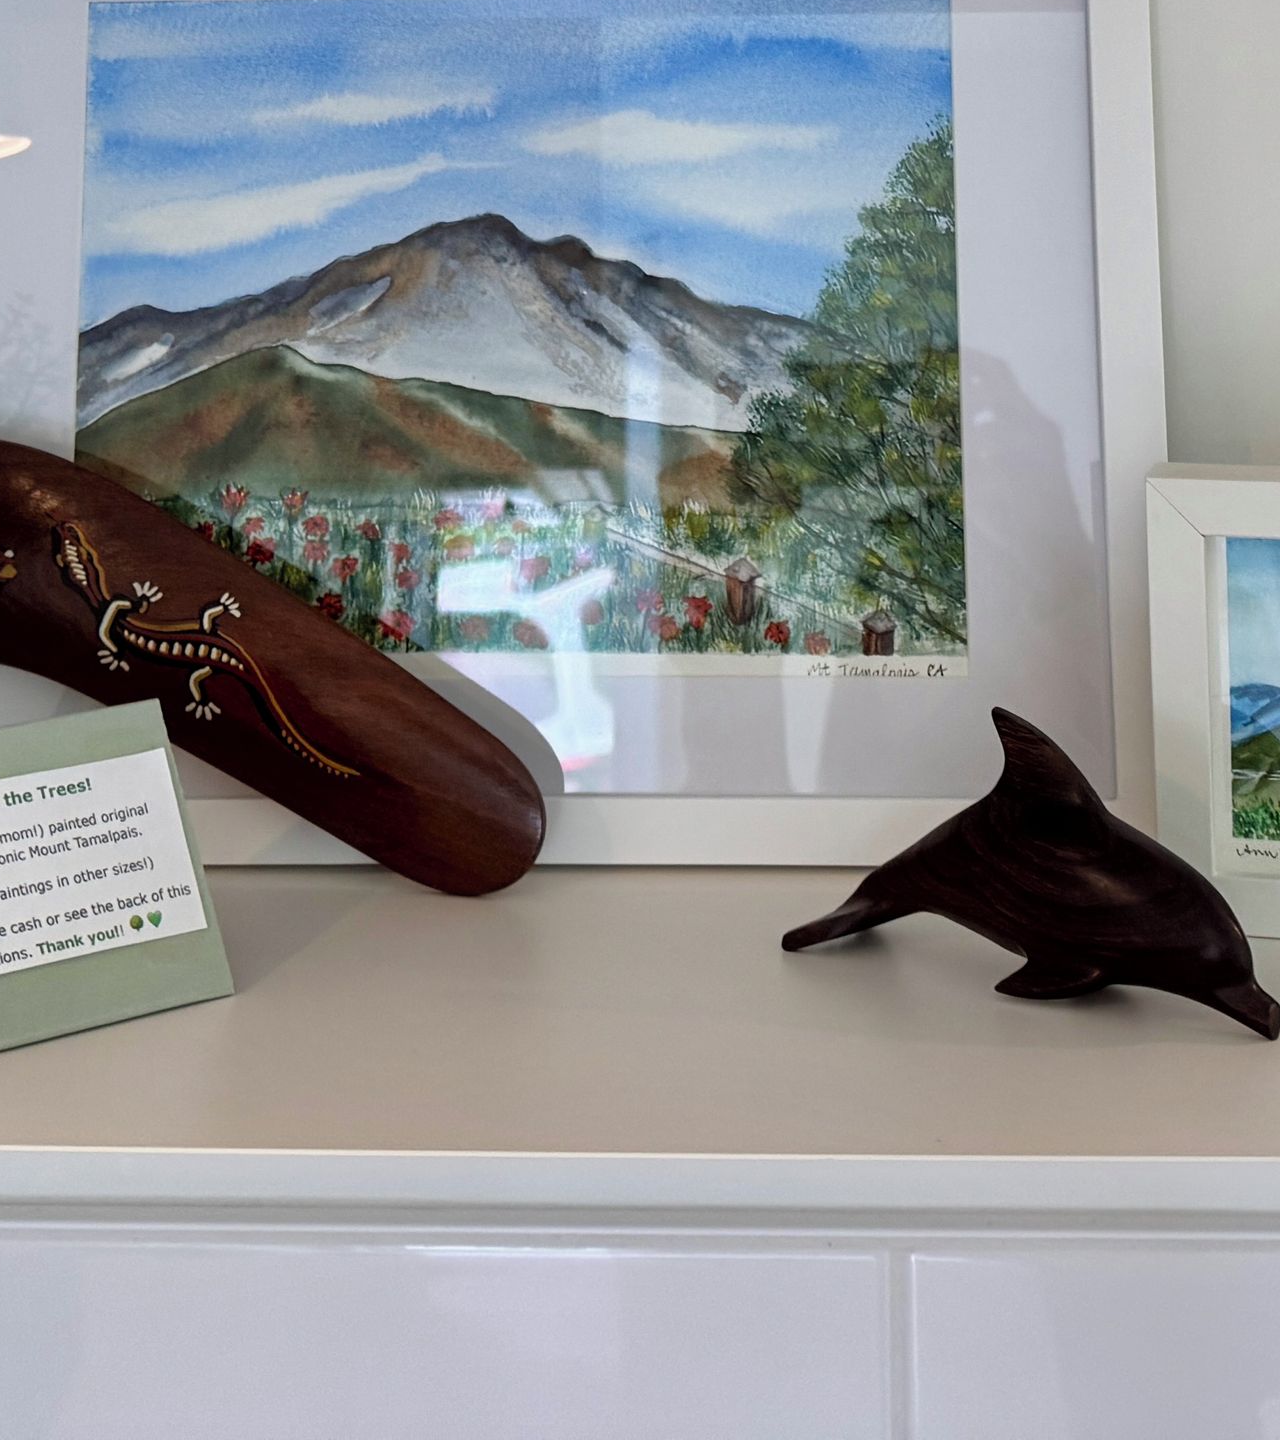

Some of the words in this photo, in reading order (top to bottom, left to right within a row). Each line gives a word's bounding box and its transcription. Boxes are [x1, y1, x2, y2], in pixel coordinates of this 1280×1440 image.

[2, 790, 34, 807] the
[36, 777, 93, 800] Trees!
[48, 812, 98, 837] painted
[100, 802, 149, 824] original
[28, 839, 72, 859] Mount
[72, 826, 143, 849] Tamalpais.
[56, 875, 70, 888] in
[73, 867, 109, 885] other
[111, 855, 154, 876] sizes!)
[10, 916, 43, 935] cash
[45, 913, 61, 927] or
[63, 907, 89, 923] see
[90, 902, 115, 916] the
[116, 892, 149, 910] back
[151, 887, 164, 903] of
[166, 884, 192, 899] this
[35, 934, 85, 956] Thank
[87, 924, 125, 946] you!!
